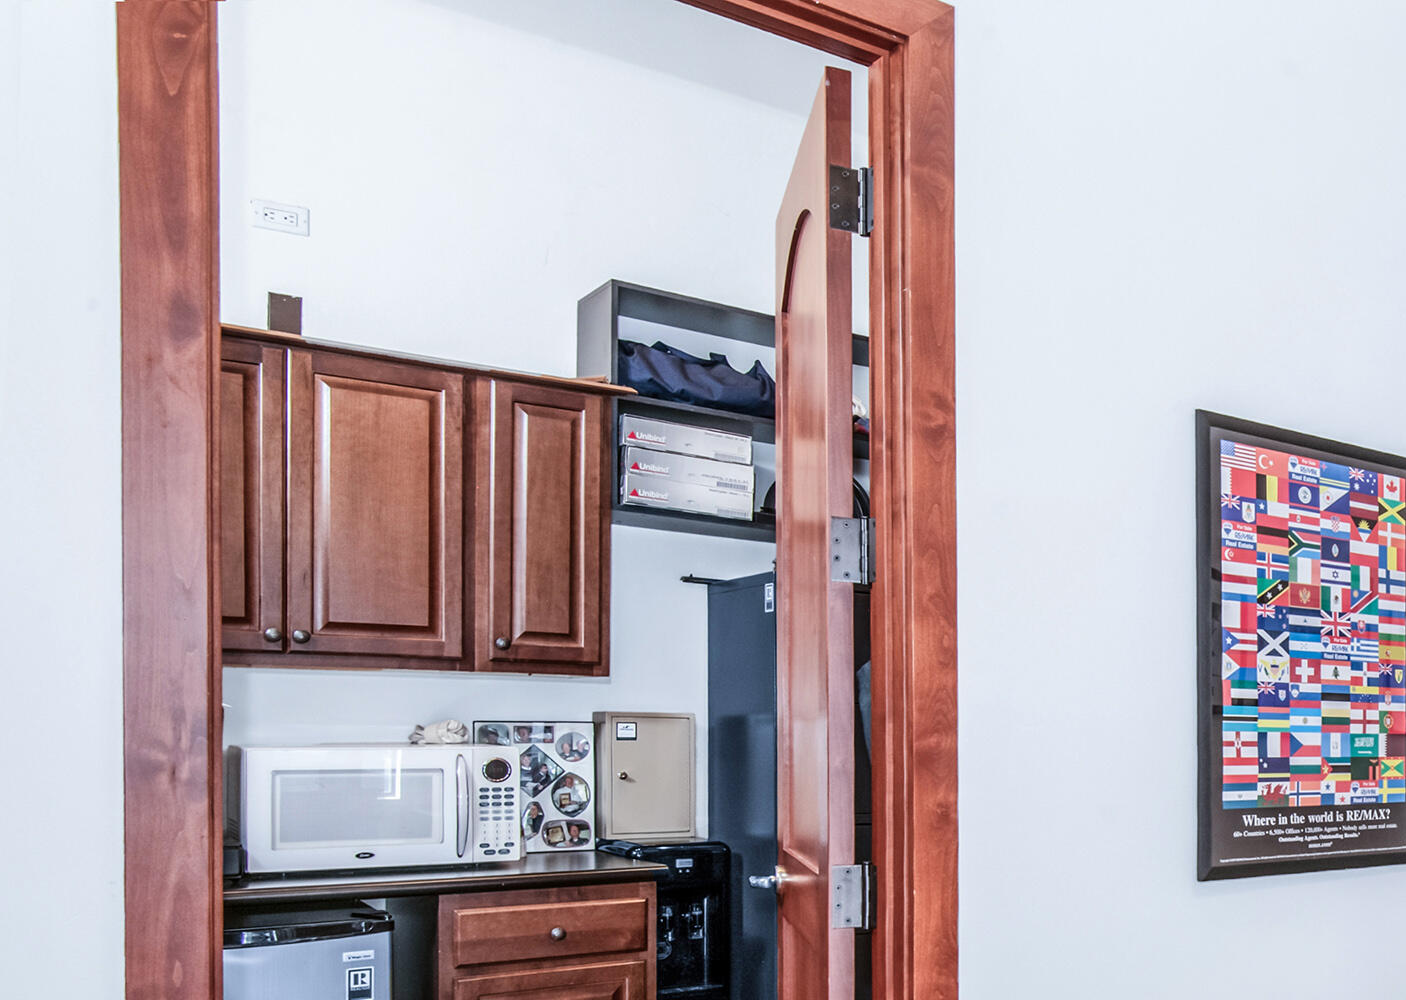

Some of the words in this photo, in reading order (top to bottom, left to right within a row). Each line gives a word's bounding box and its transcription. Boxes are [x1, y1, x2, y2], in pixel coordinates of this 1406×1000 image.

[1242, 814, 1277, 827] Where
[1278, 813, 1288, 825] in
[1290, 812, 1306, 825] the
[1308, 811, 1334, 824] world
[1336, 811, 1344, 822] is
[1346, 808, 1391, 822] RE/MAX?
